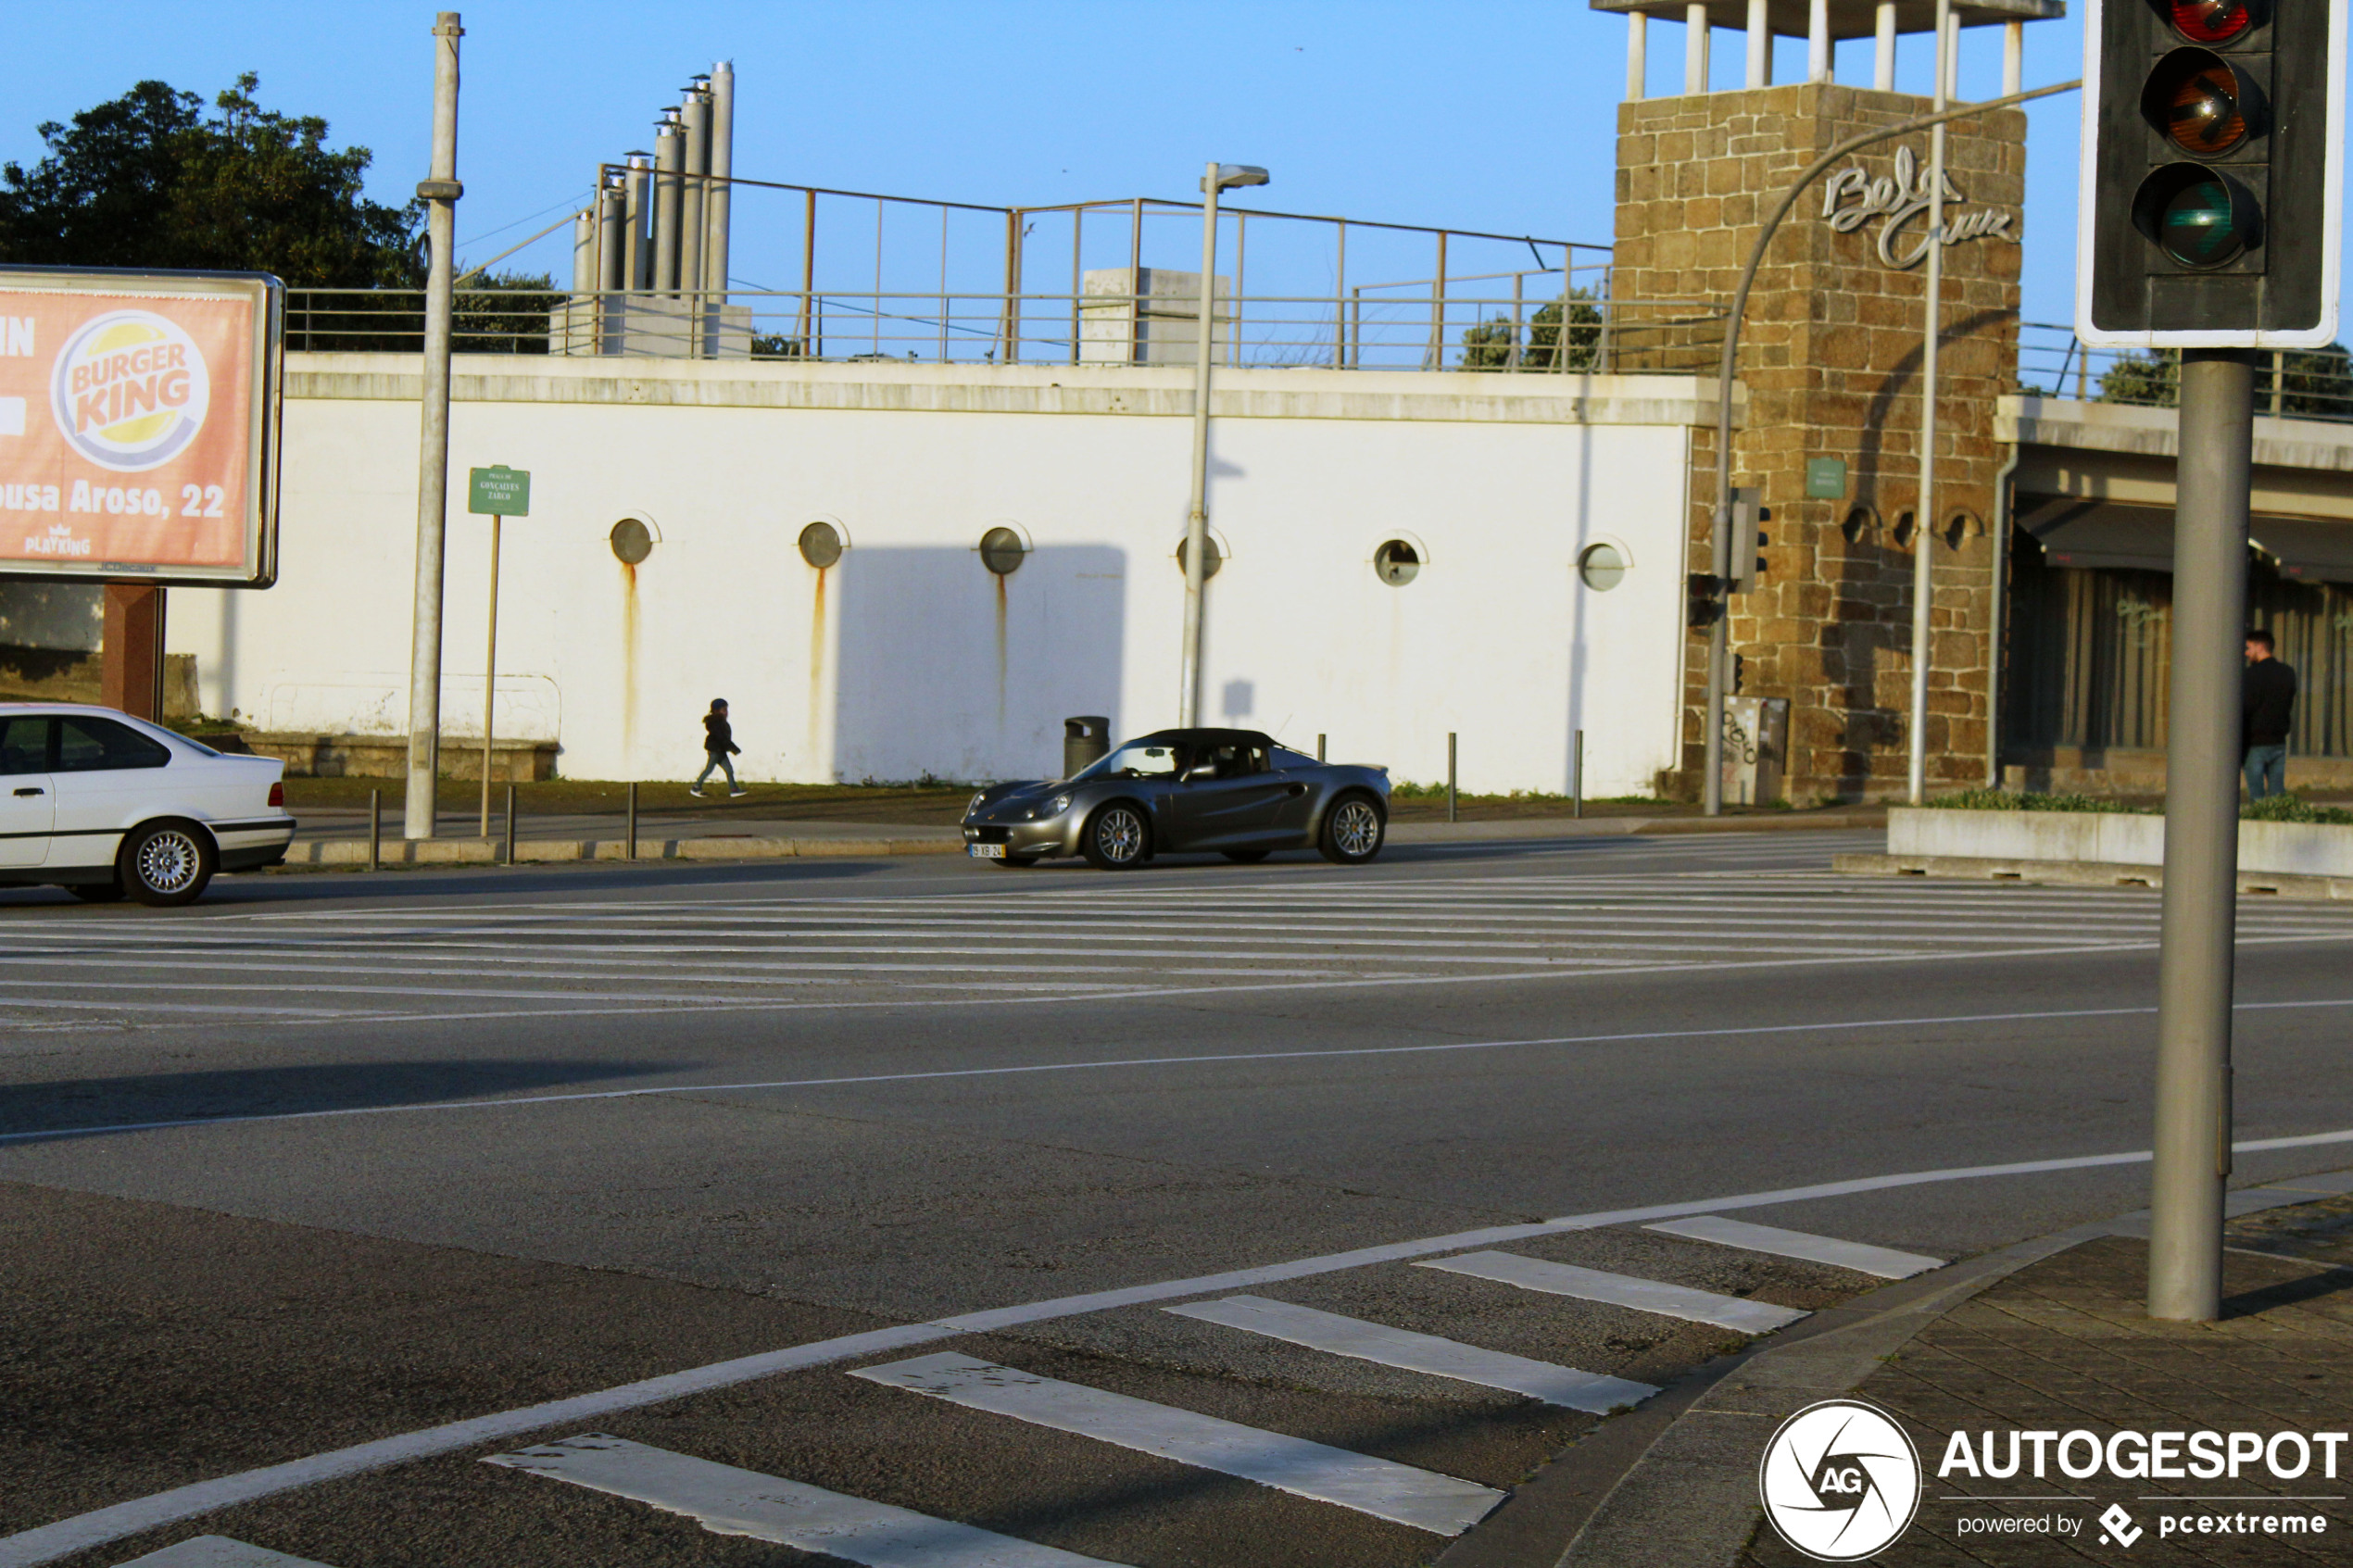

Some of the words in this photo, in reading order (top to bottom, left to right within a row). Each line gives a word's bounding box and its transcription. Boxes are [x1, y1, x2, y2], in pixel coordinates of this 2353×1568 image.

[1822, 145, 1962, 232] Bela
[72, 343, 186, 395] BURGER
[76, 369, 191, 434] KING
[0, 483, 59, 511] usa
[69, 480, 170, 520] Aroso,
[182, 484, 224, 518] 22
[480, 481, 520, 492] GONÇALVES
[488, 491, 510, 500] ZARCO
[25, 535, 91, 556] PLAYKING
[97, 561, 157, 572] JCDecaux
